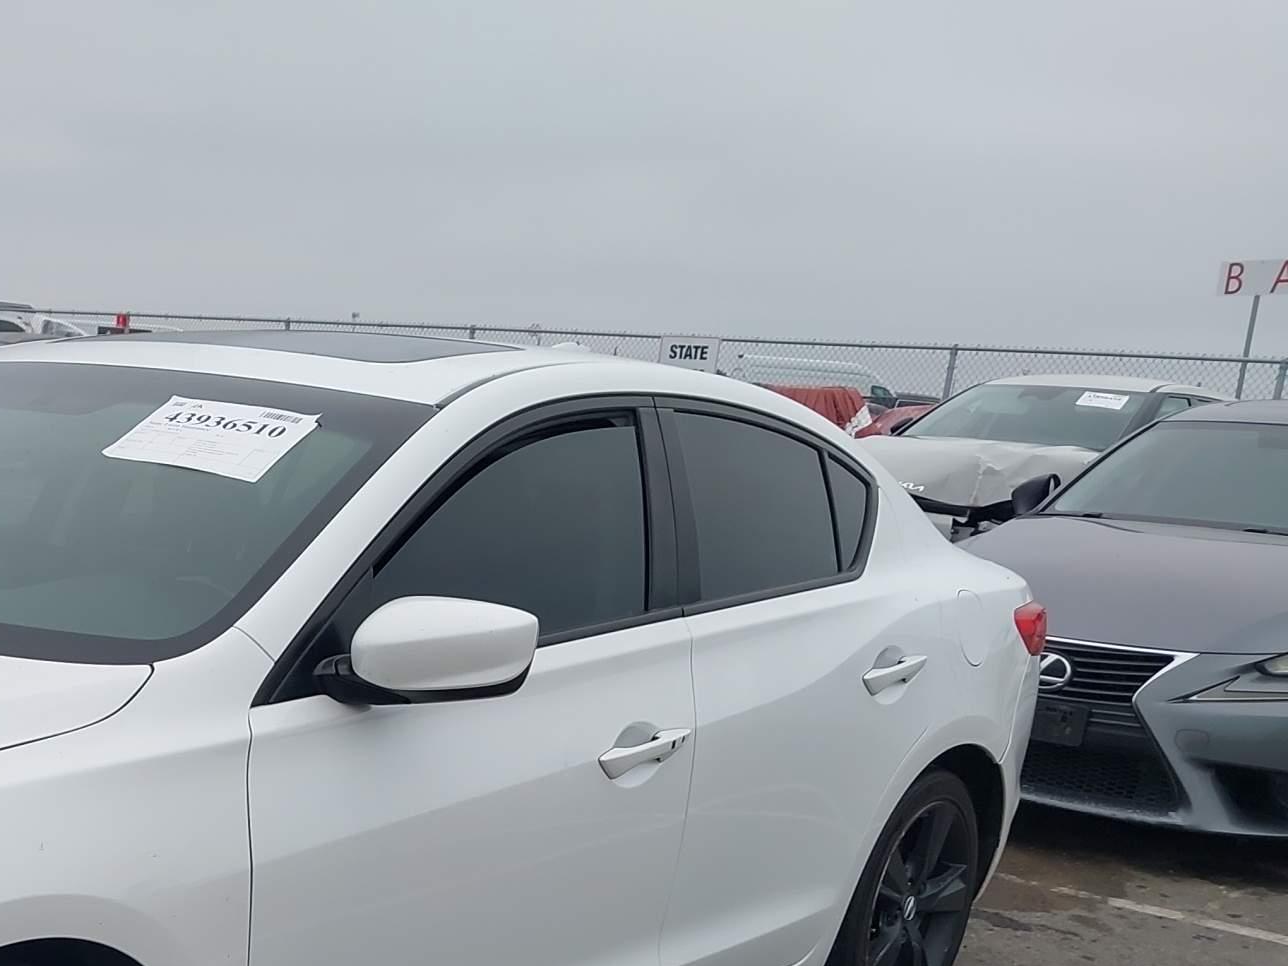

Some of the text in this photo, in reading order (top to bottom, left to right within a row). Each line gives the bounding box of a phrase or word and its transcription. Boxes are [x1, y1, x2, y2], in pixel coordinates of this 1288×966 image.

[1223, 262, 1245, 295] B
[669, 344, 709, 360] STATE
[165, 411, 287, 439] 43936510
